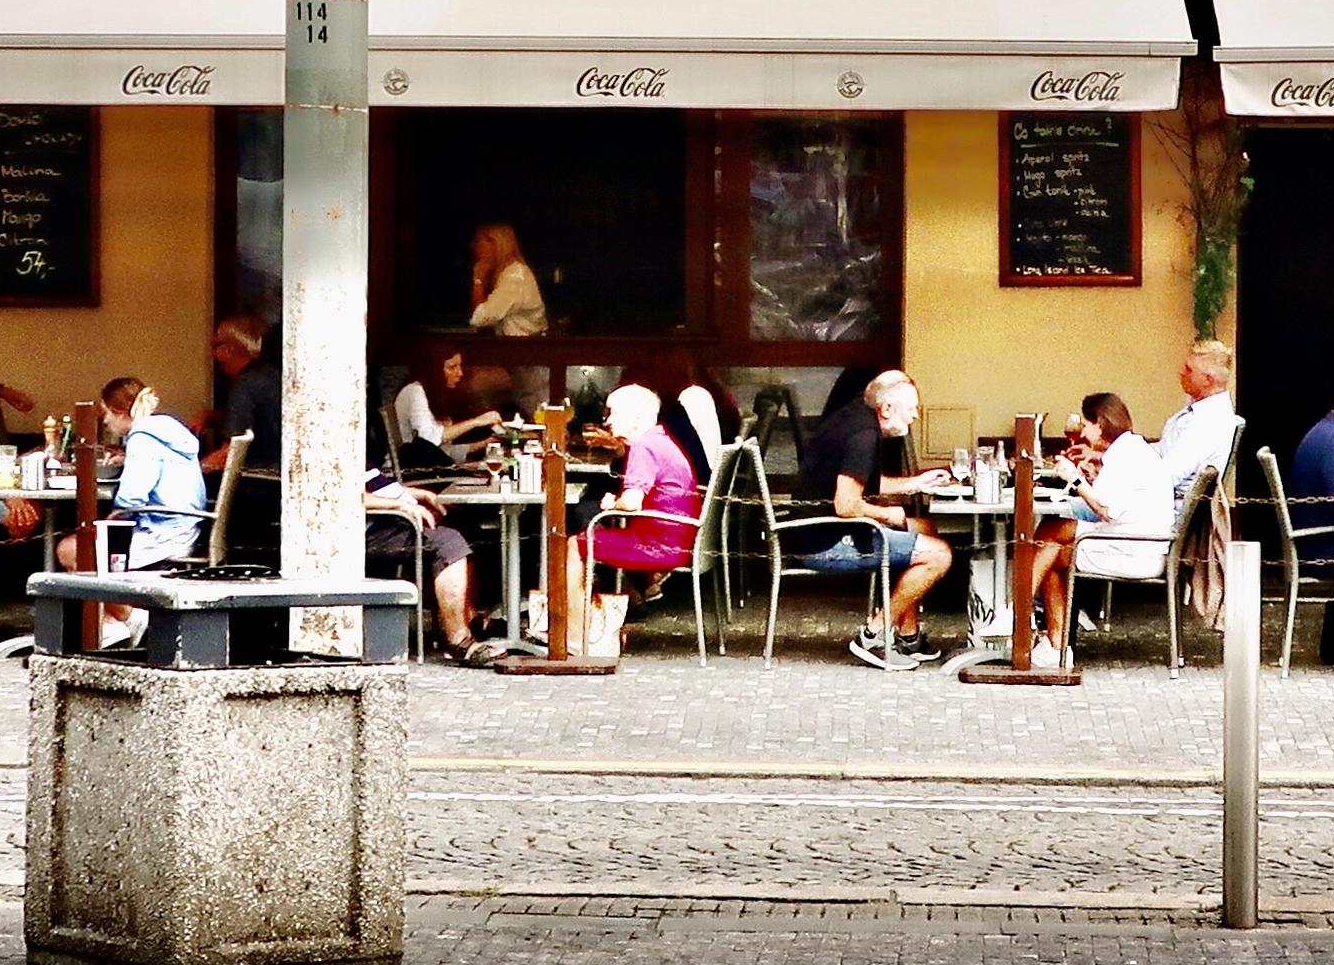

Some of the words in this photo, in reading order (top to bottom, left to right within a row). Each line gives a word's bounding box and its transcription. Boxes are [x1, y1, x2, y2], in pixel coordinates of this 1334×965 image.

[296, 1, 327, 21] 114
[307, 24, 327, 44] 14
[122, 65, 216, 96] Coca-Cola
[576, 67, 671, 98] Coca-Cola
[1030, 70, 1126, 102] Coca-Cola
